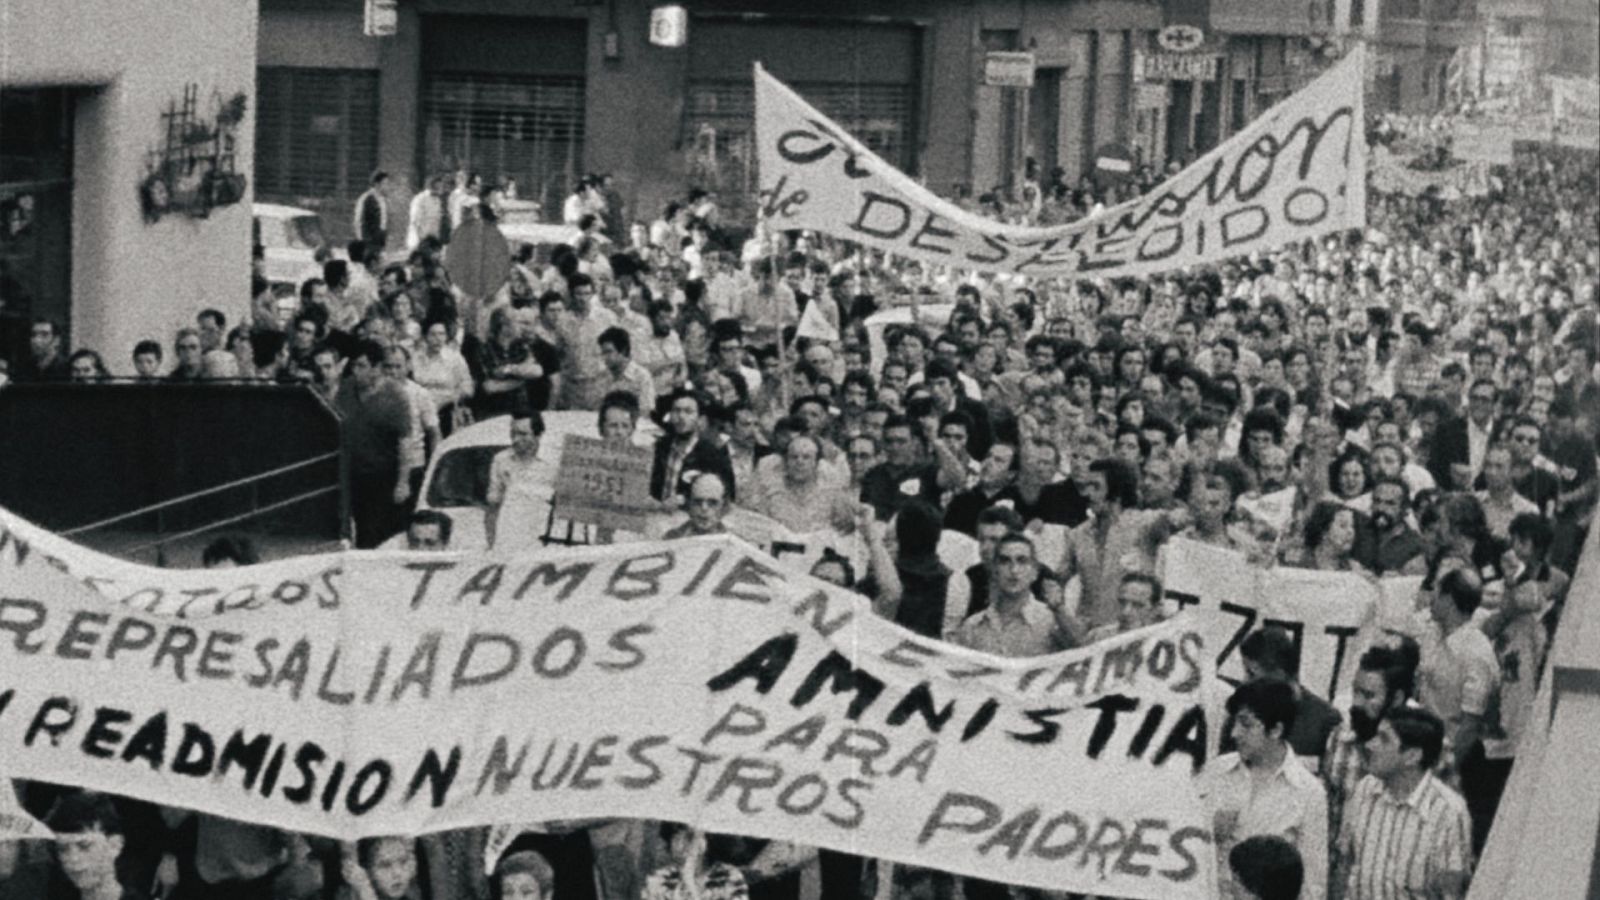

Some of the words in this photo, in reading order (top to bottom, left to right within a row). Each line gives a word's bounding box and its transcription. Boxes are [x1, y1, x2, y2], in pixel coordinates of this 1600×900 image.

[760, 175, 809, 218] de
[402, 547, 853, 638] TAMBIEN
[0, 598, 654, 704] REPRESALIADOS
[706, 633, 1209, 776] AMNISTIA
[701, 704, 938, 783] PARA
[24, 696, 461, 815] READMISION
[475, 733, 874, 829] NUESTROS
[917, 792, 1210, 883] PADRES
